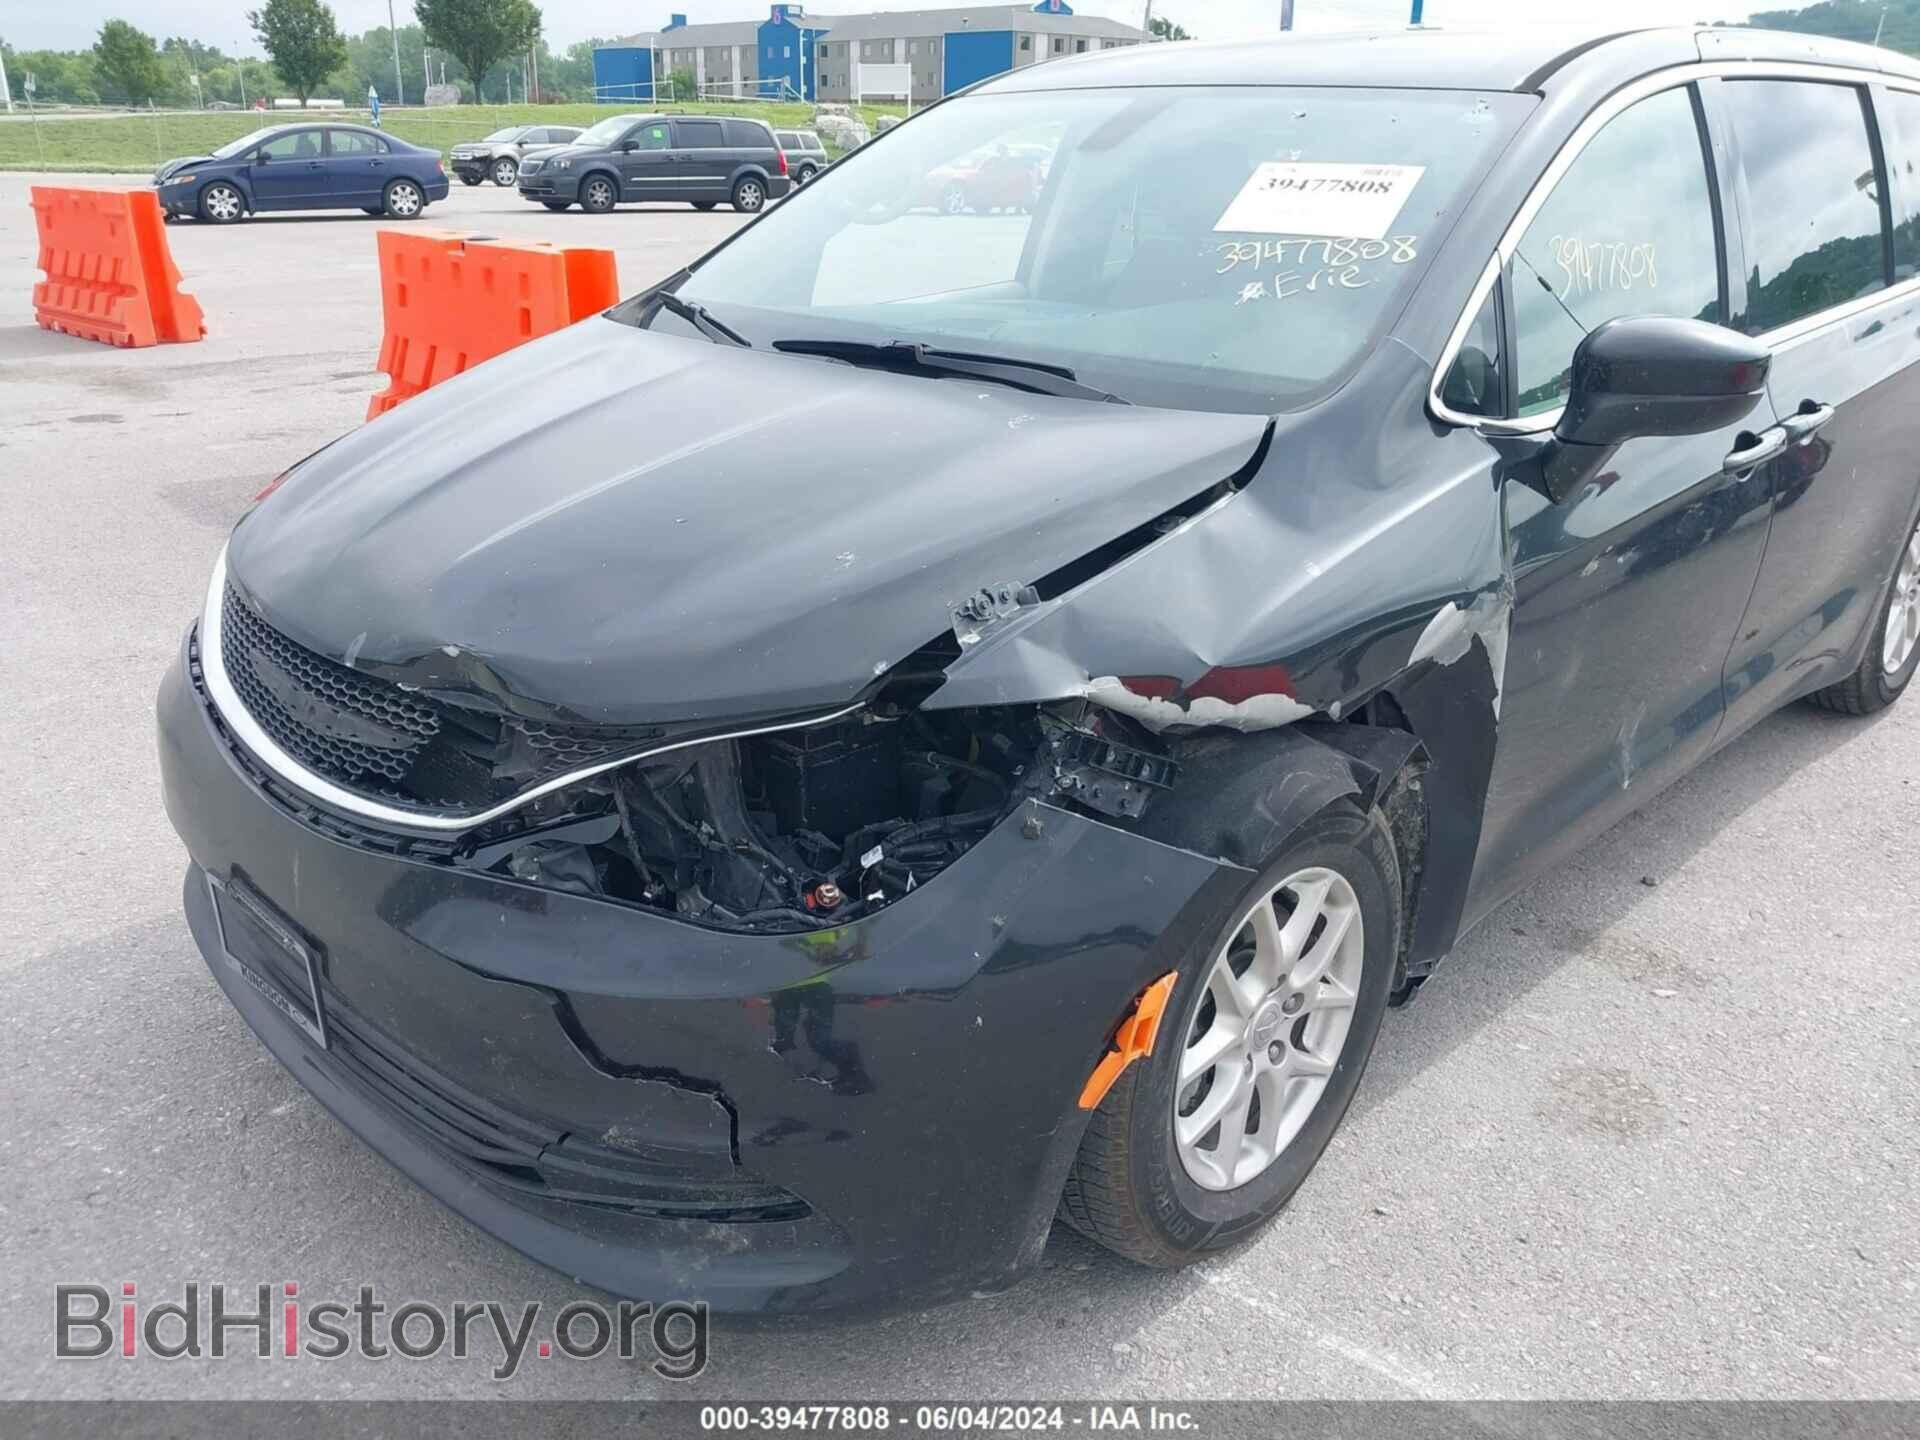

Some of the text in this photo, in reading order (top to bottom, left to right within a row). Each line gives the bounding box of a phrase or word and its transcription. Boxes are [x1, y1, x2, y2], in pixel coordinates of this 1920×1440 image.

[1259, 177, 1393, 195] 39477808
[1215, 235, 1417, 274] 39477808
[1547, 234, 1657, 302] 39477808
